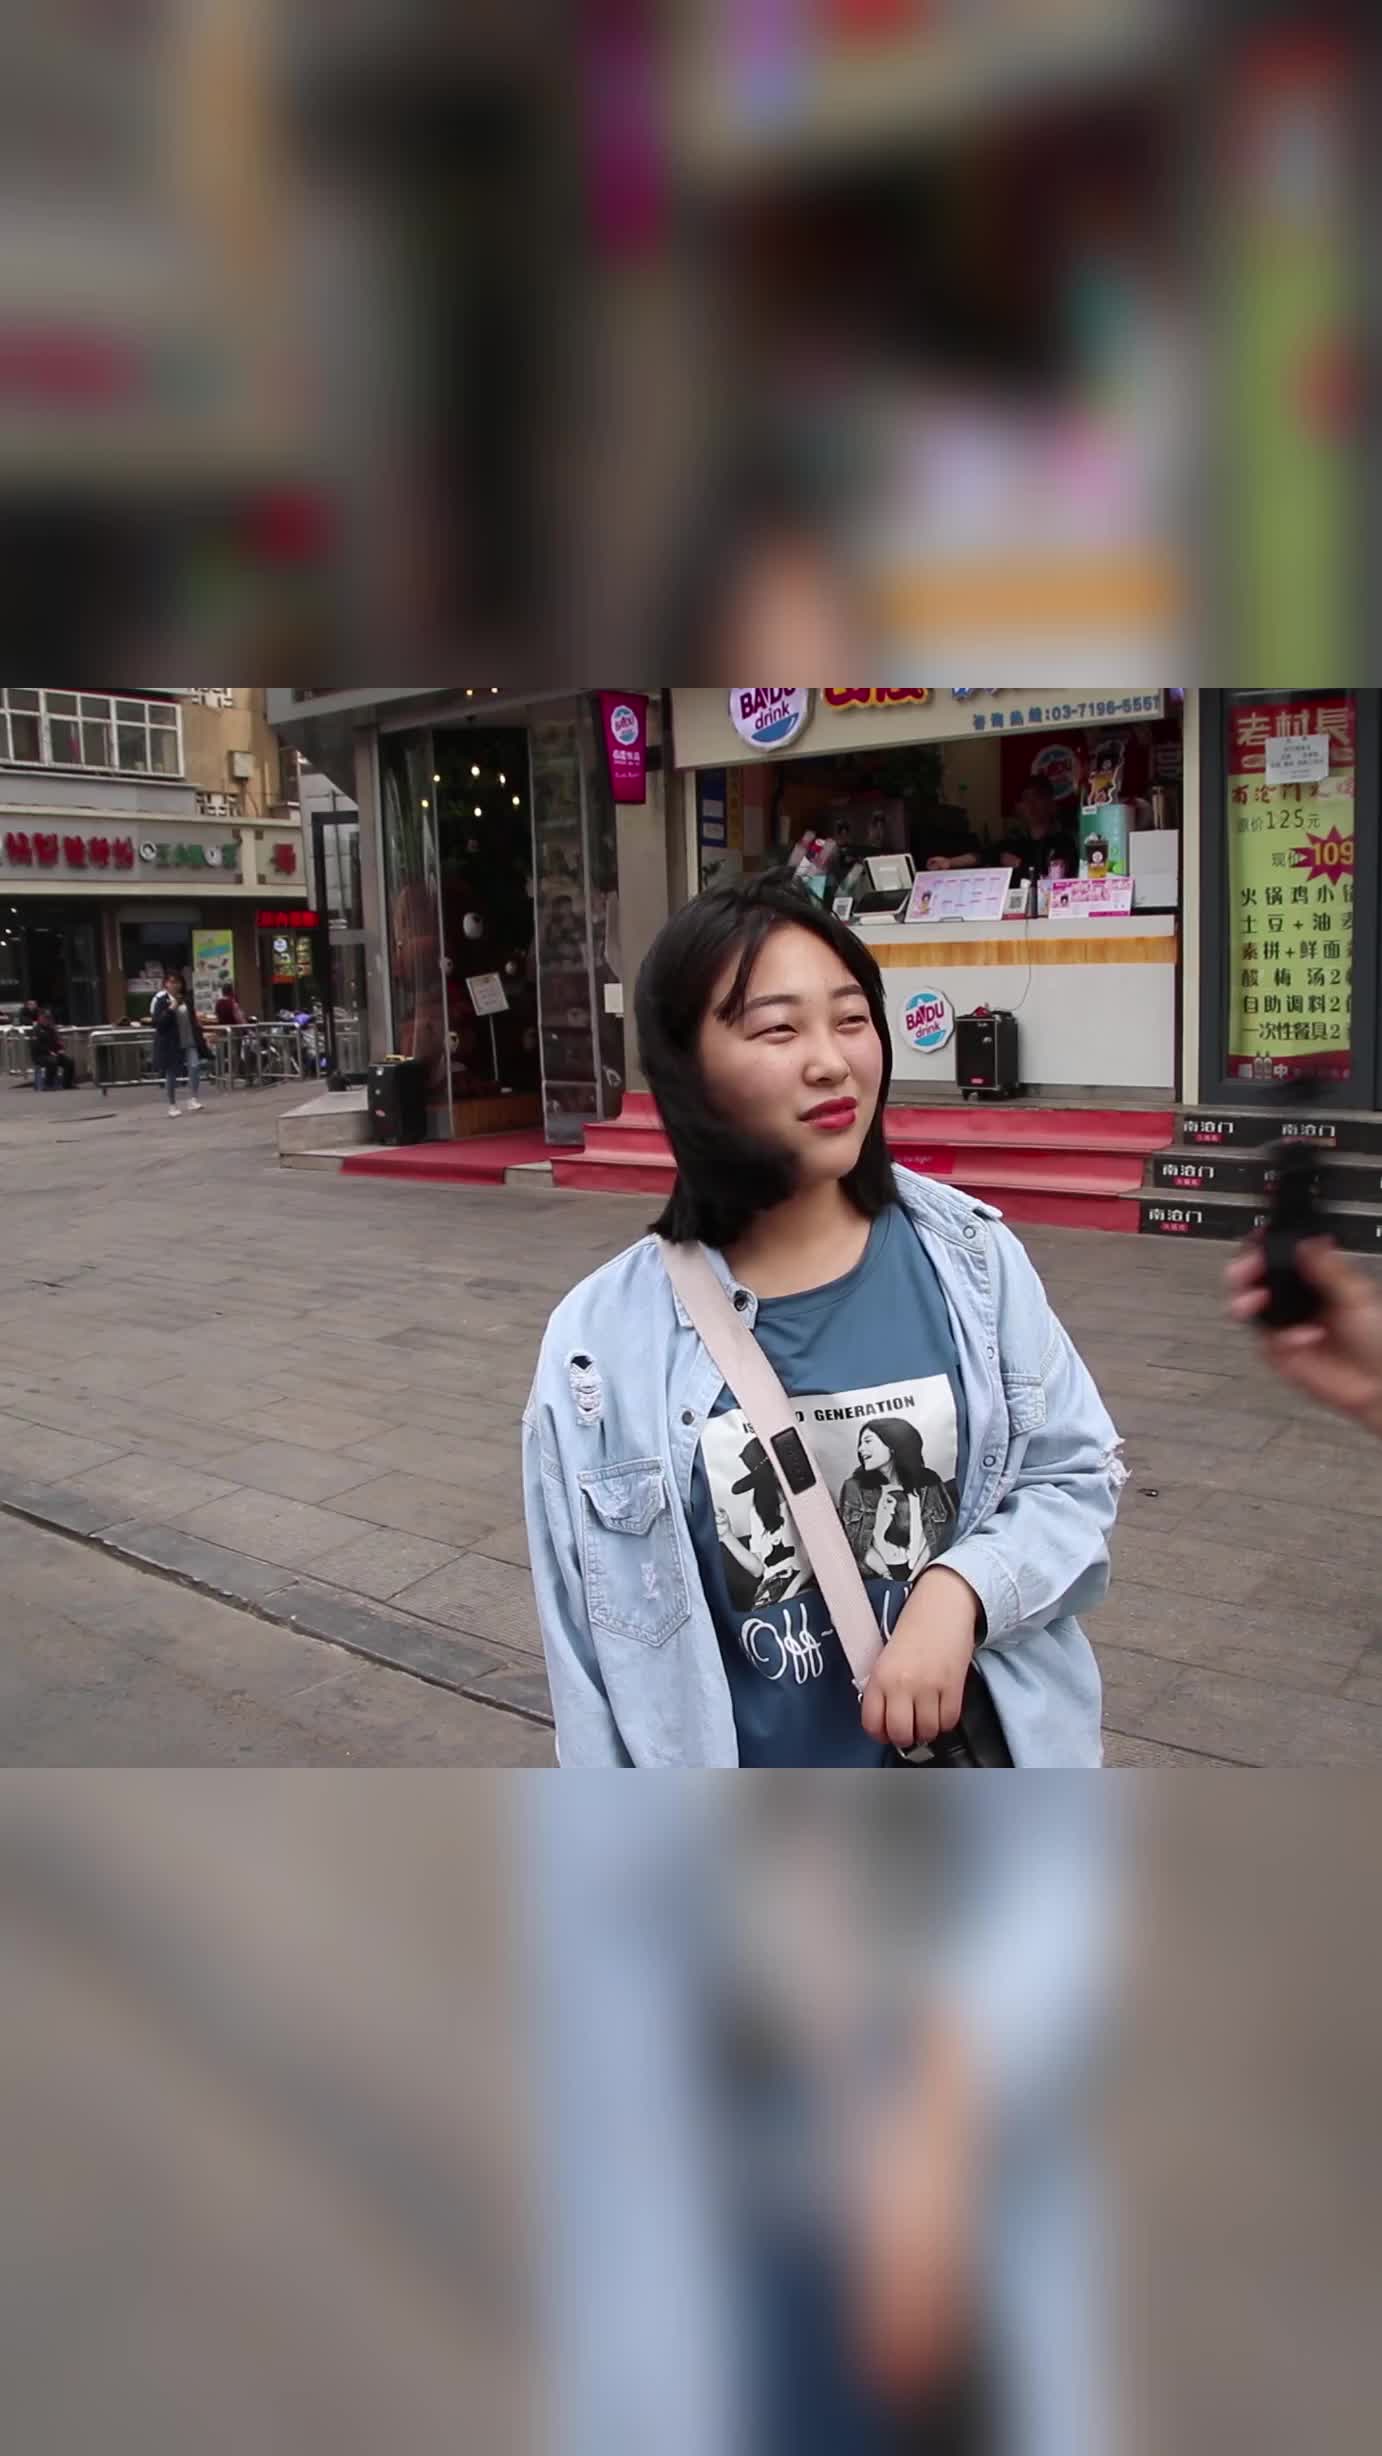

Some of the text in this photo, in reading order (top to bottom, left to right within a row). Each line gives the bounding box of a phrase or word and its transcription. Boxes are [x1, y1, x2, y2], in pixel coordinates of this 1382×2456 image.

[755, 700, 790, 730] drink
[1243, 994, 1351, 1014] 自助调料2
[915, 1020, 941, 1039] drink
[1242, 1021, 1351, 1041] 一次性餐具2
[814, 1395, 915, 1423] GENERATION
